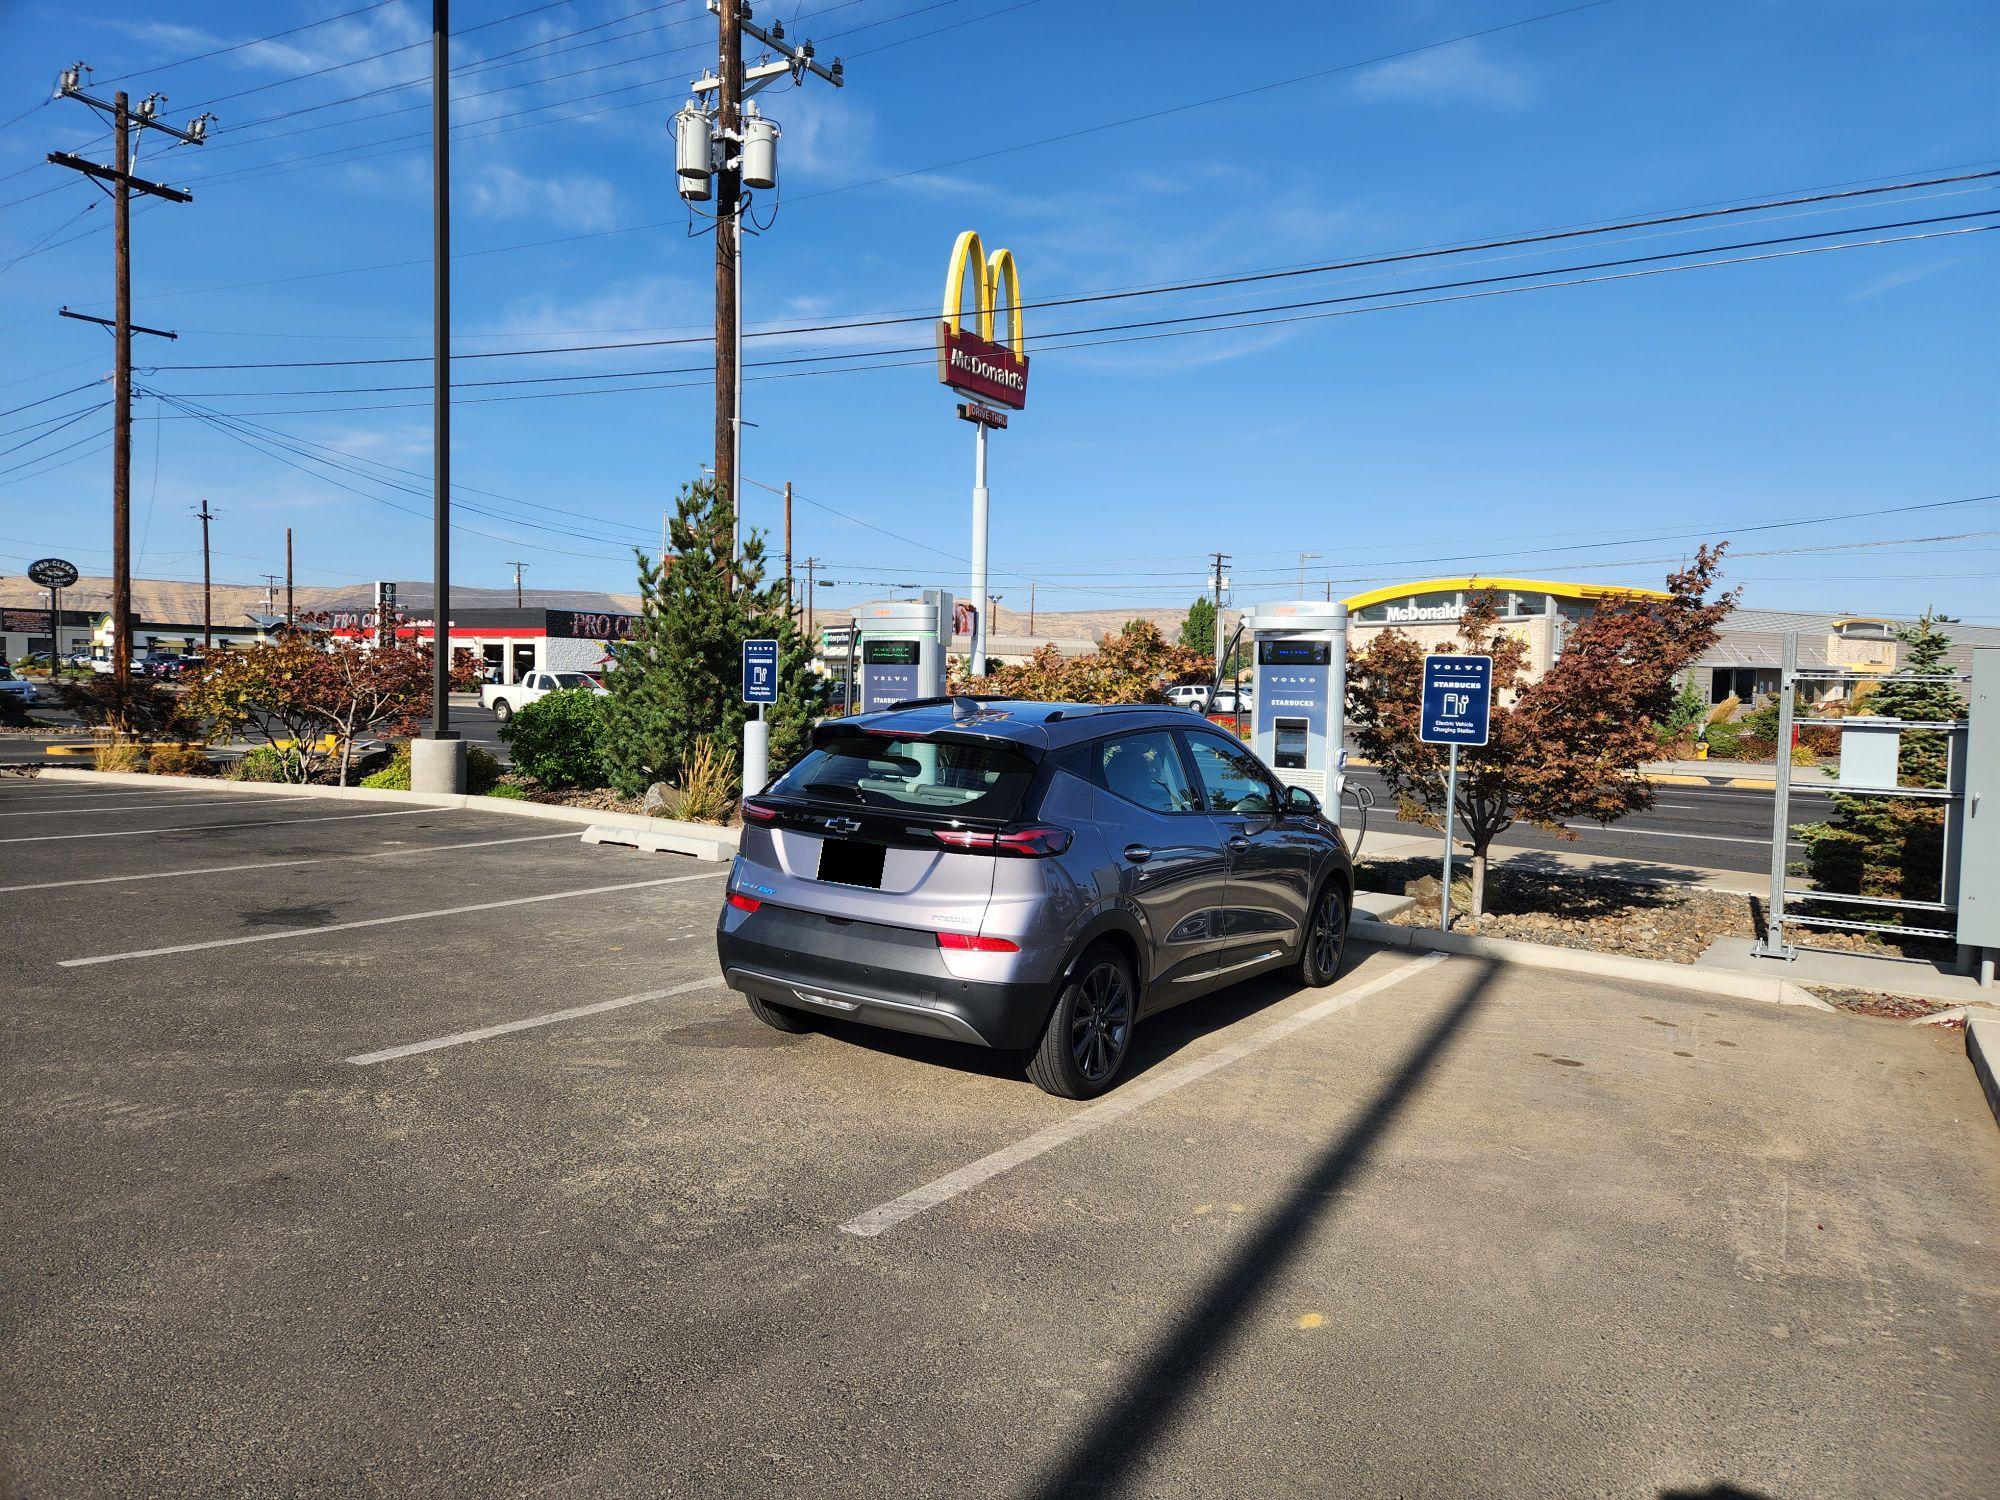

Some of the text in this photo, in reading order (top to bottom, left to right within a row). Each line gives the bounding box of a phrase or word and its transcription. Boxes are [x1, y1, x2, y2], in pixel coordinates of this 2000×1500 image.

[951, 348, 1024, 391] McDonald's
[971, 406, 1007, 426] DRIVE-THRU
[1386, 603, 1469, 622] McDonald's
[572, 613, 610, 638] PRO
[1433, 681, 1482, 689] STARBUCKS
[1271, 699, 1314, 707] STARBUCKS
[1432, 726, 1456, 734] Charging
